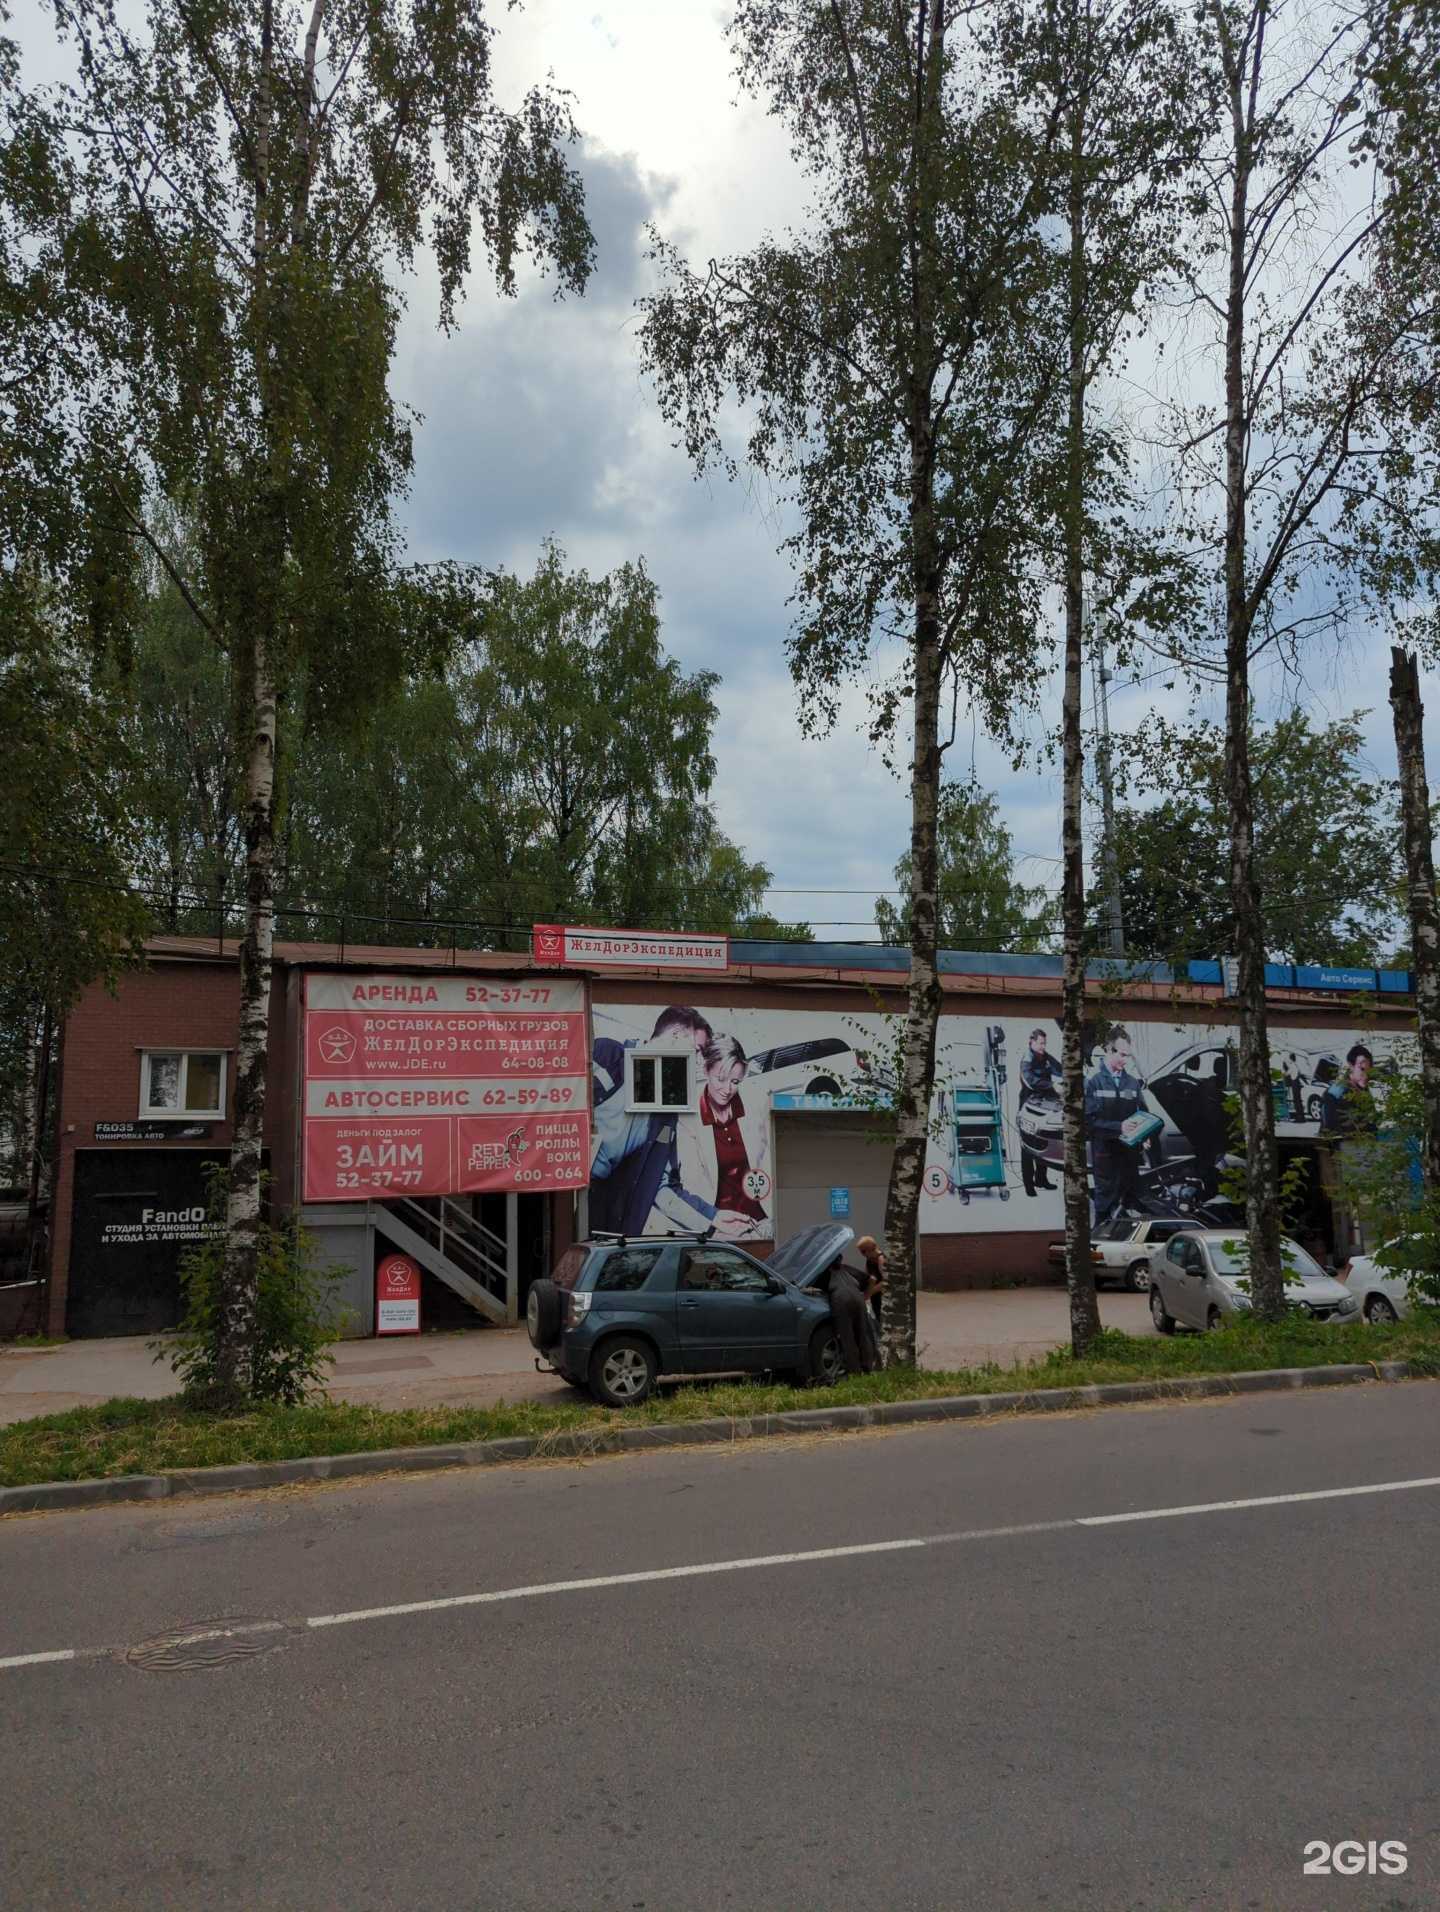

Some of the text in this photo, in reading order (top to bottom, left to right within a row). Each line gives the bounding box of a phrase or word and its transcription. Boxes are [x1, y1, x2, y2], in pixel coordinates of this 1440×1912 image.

[352, 985, 552, 1004] АРЕНДА 52-37-77
[363, 1019, 569, 1032] ДОСТАВКА СБОРНЫХ ГРУЗОВ
[366, 1058, 446, 1070] www.JDE.ru
[501, 1057, 569, 1069] 64-08-08
[324, 1088, 573, 1108] АВТОСЕРВИС 62-59-89
[336, 1128, 423, 1138] ДЕНЬГИ ПОД ЗАЛОГ
[536, 1124, 579, 1136] ПИЦЦА
[535, 1138, 581, 1150] РОЛЛЫ
[336, 1139, 423, 1169] ЗАЙМ
[472, 1143, 505, 1158] RED
[547, 1152, 581, 1163] ВОКИ
[336, 1171, 423, 1188] 52-37-77
[747, 1176, 765, 1189] 3,5
[932, 1174, 941, 1188] 5
[105, 1225, 143, 1233] СТУДИЯ
[144, 1223, 199, 1232] УСТАНОВКИ
[102, 1235, 109, 1243] И
[111, 1233, 144, 1242] УХОДА
